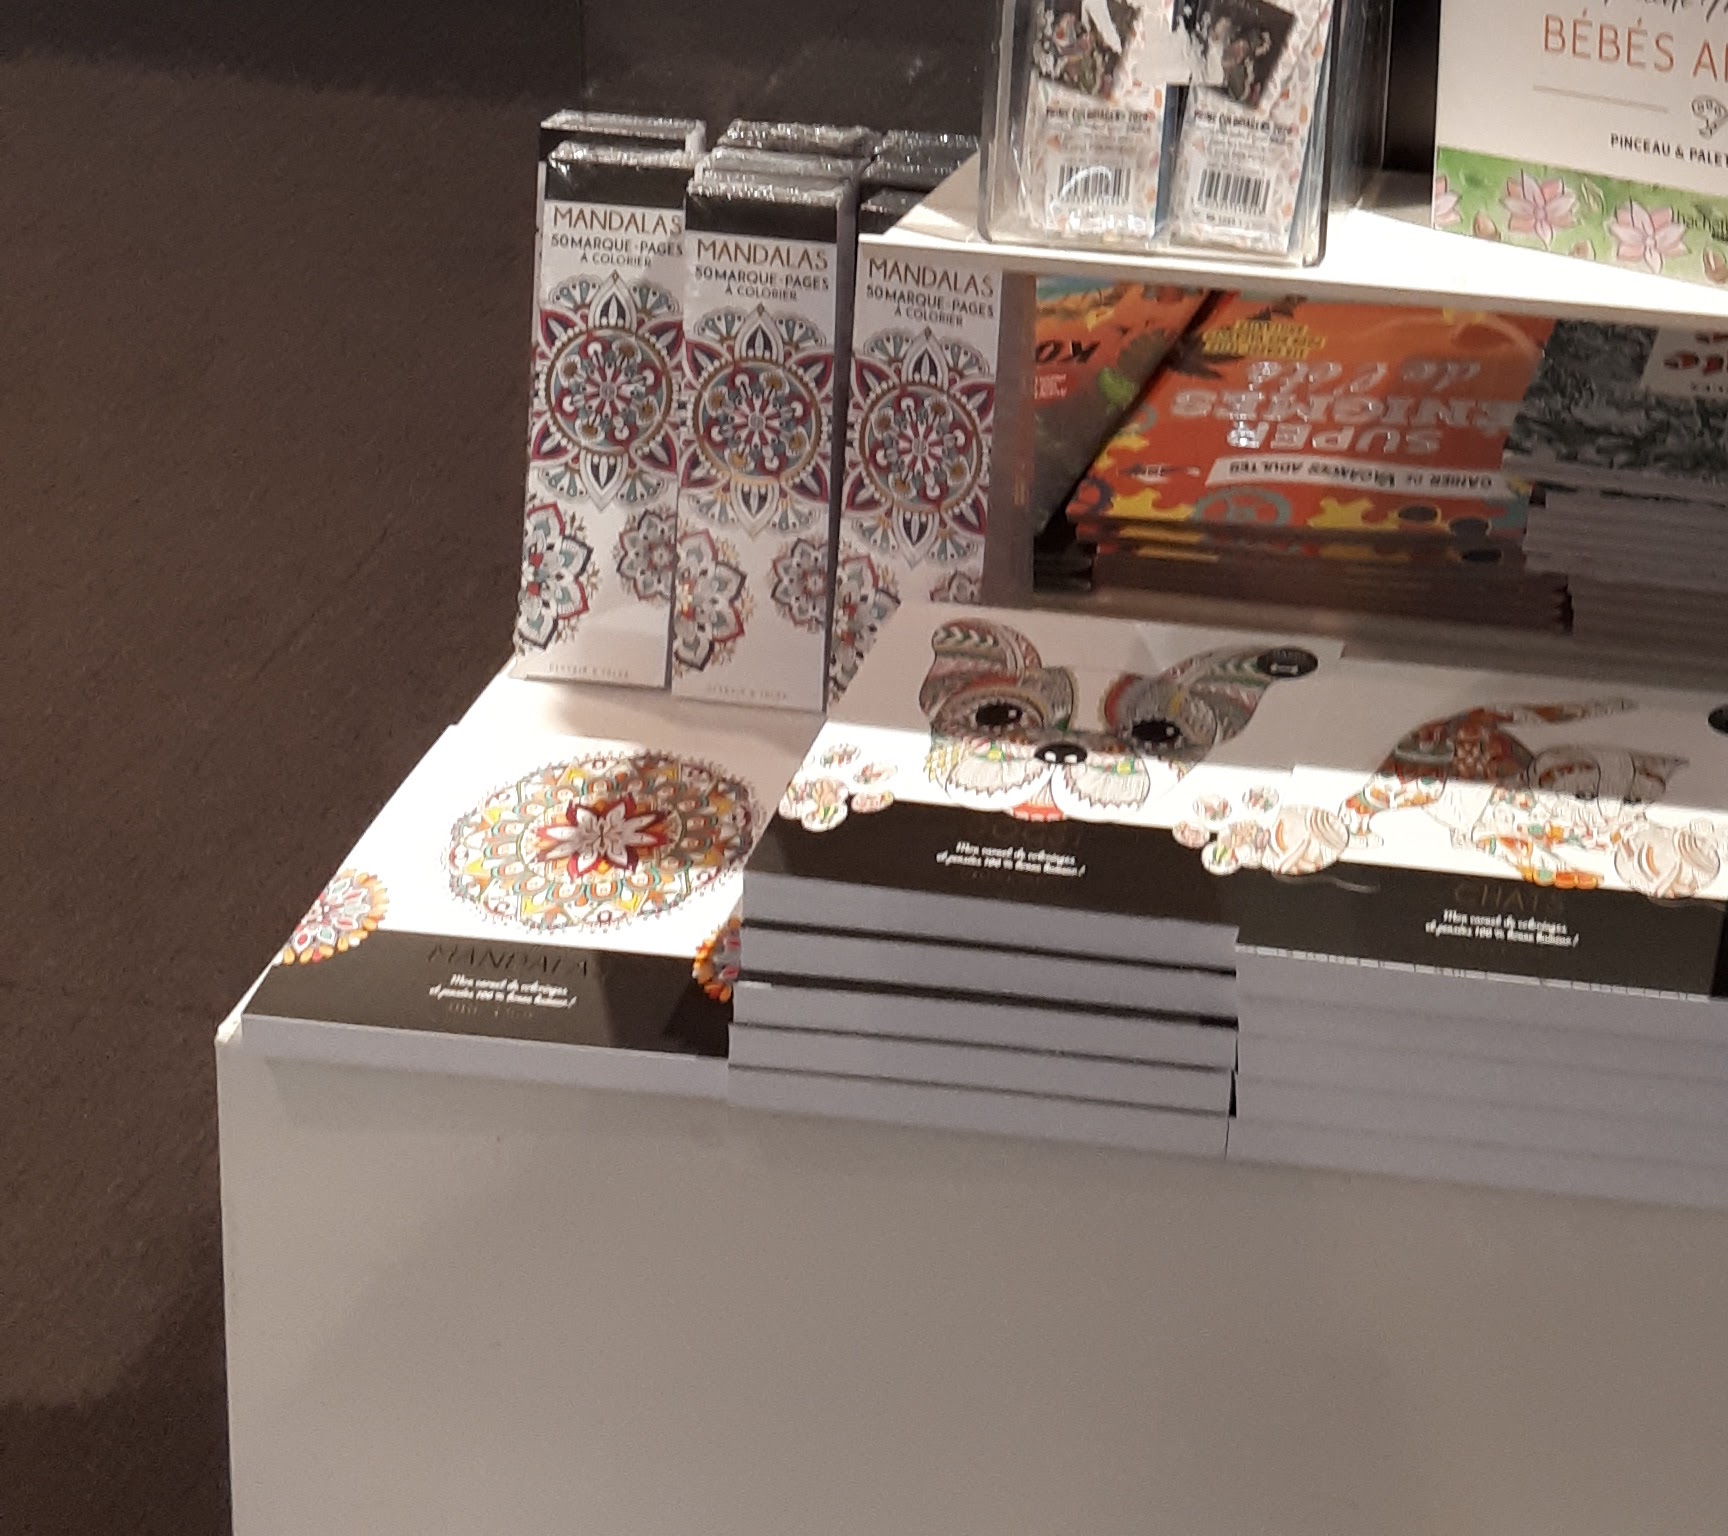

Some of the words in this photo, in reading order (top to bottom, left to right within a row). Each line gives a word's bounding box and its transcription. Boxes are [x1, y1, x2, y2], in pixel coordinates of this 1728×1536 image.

[1544, 8, 1675, 72] BÉBÉS
[1610, 132, 1671, 157] PINCEAU
[1675, 144, 1685, 160] &
[552, 206, 683, 237] MANDALAS
[592, 253, 652, 269] COLORIER
[696, 239, 828, 271] MANDALAS
[736, 285, 798, 302] COLORIER
[869, 258, 994, 299] MANDALAS
[1227, 421, 1442, 454] SUPER
